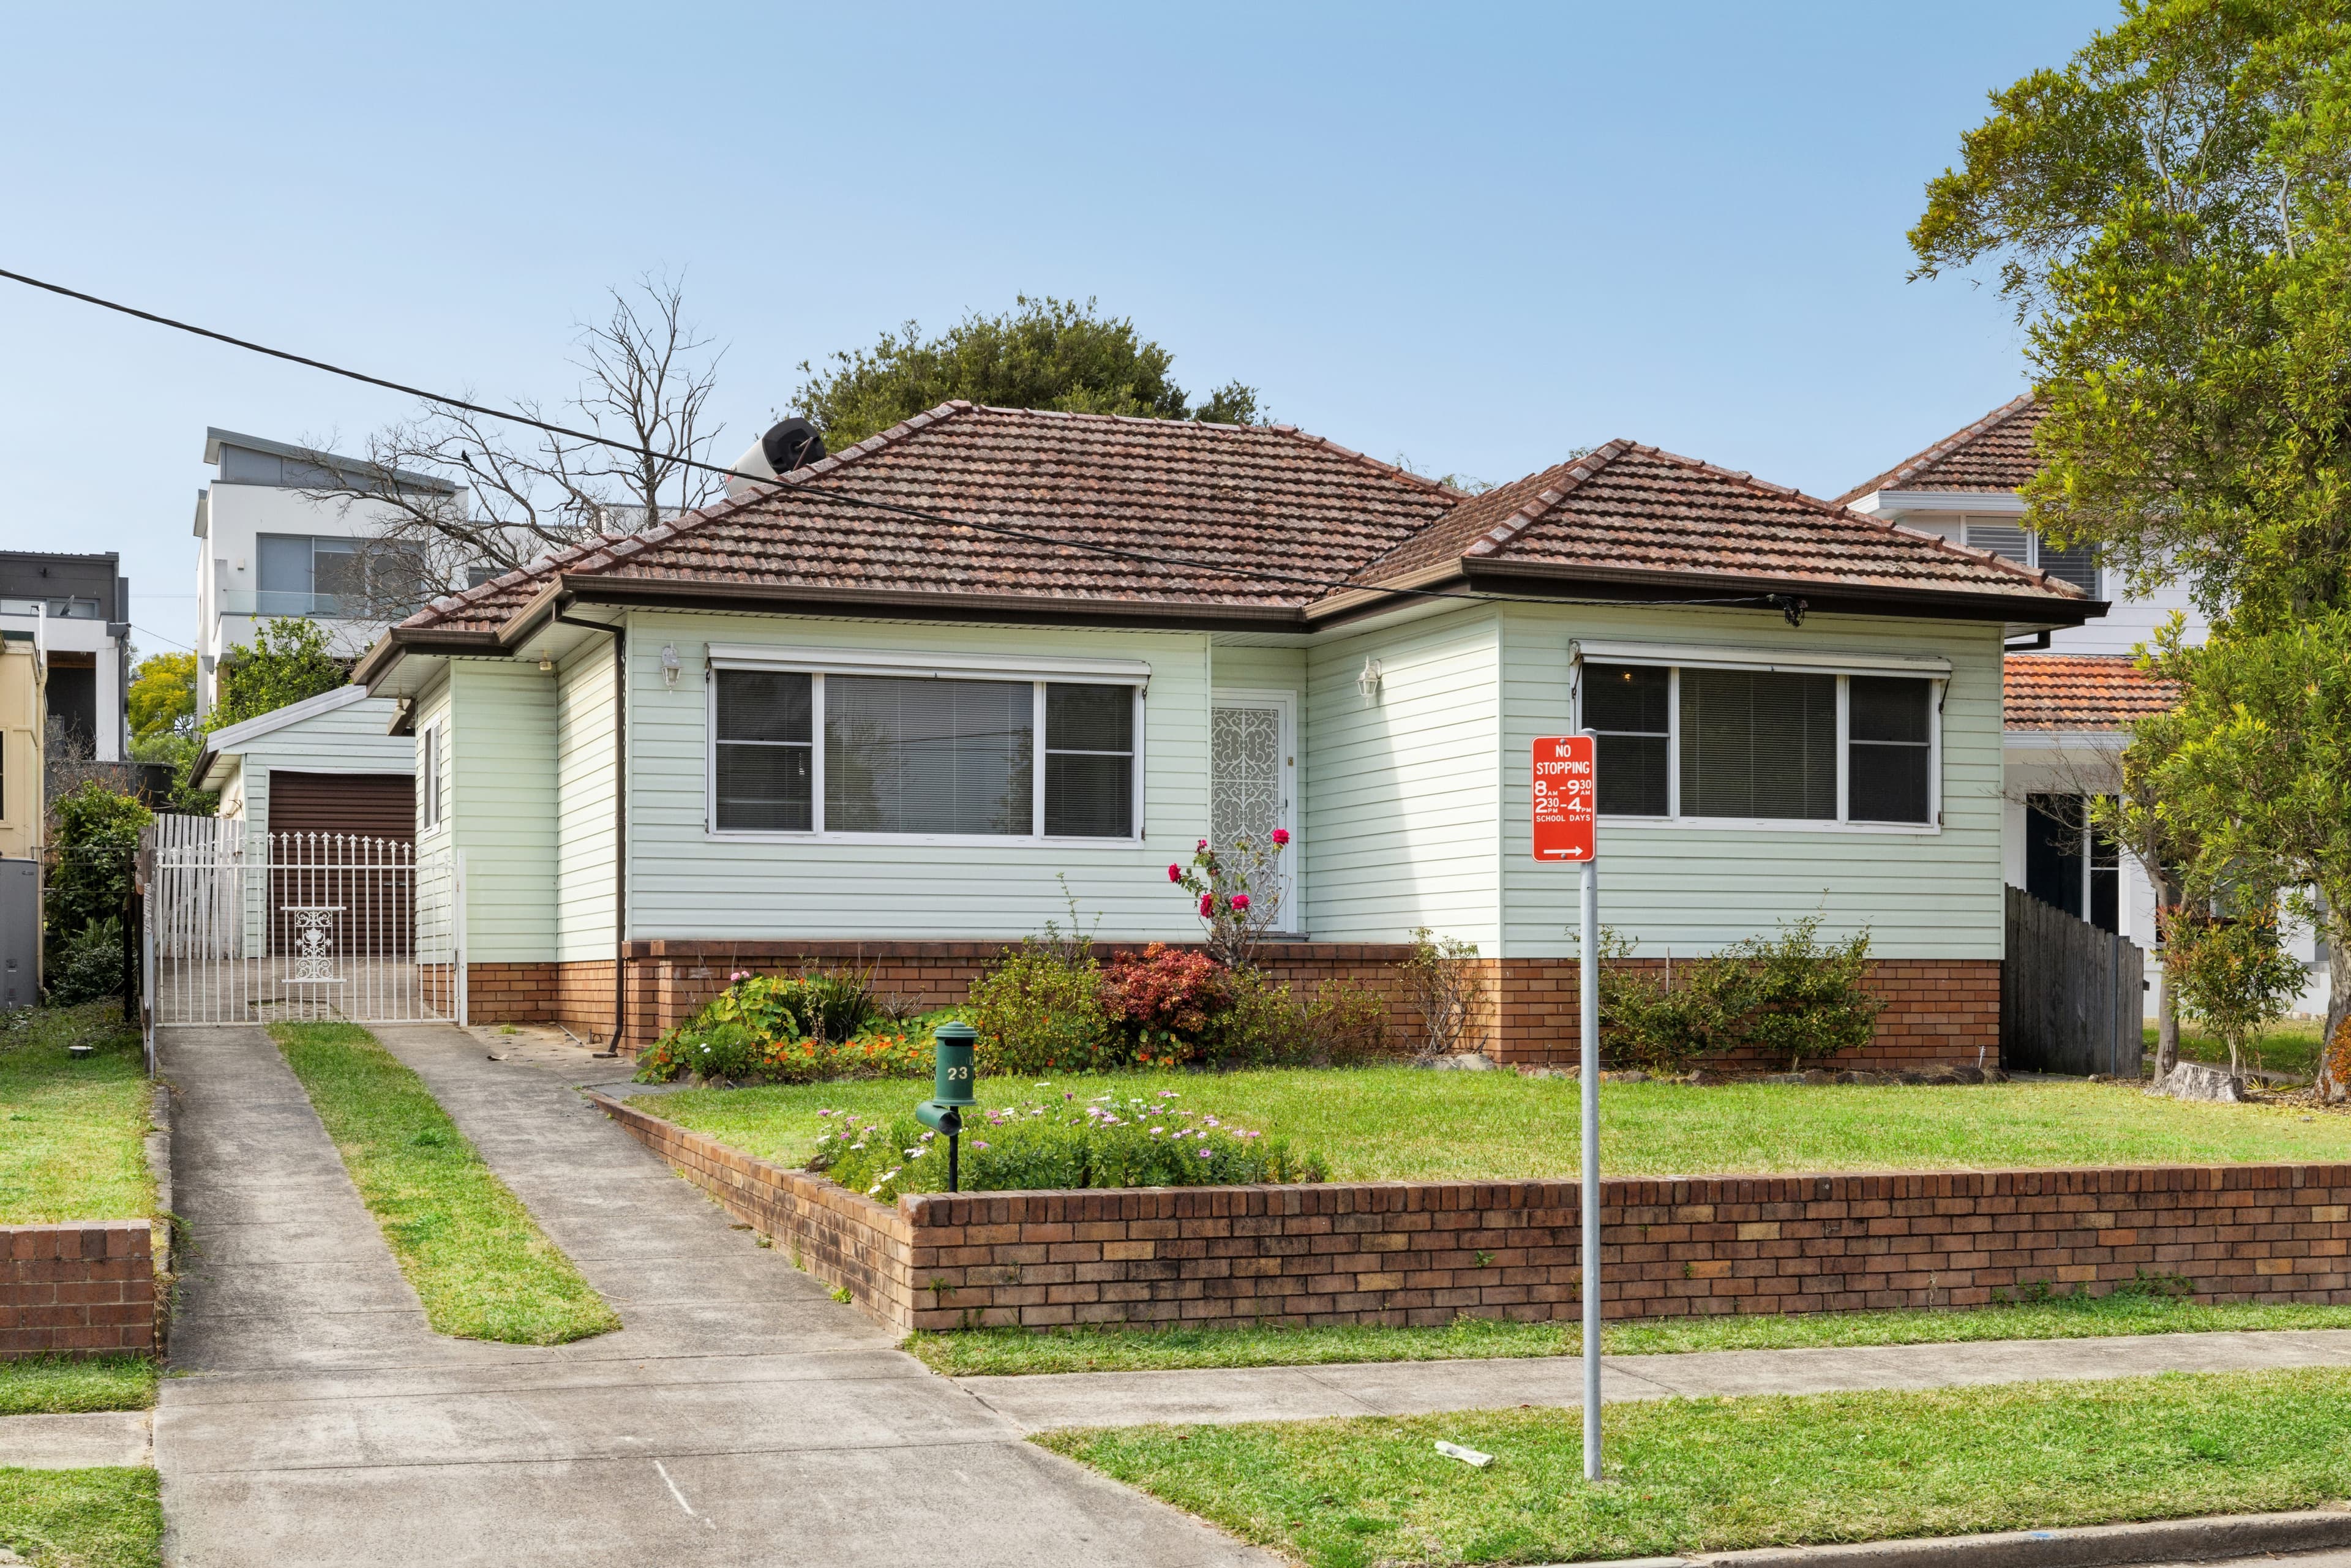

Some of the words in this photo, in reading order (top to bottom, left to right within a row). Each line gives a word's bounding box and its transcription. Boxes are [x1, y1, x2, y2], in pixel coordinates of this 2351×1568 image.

[1556, 745, 1571, 757] NO
[1536, 761, 1590, 775] STOPPING
[948, 1067, 968, 1080] 23
